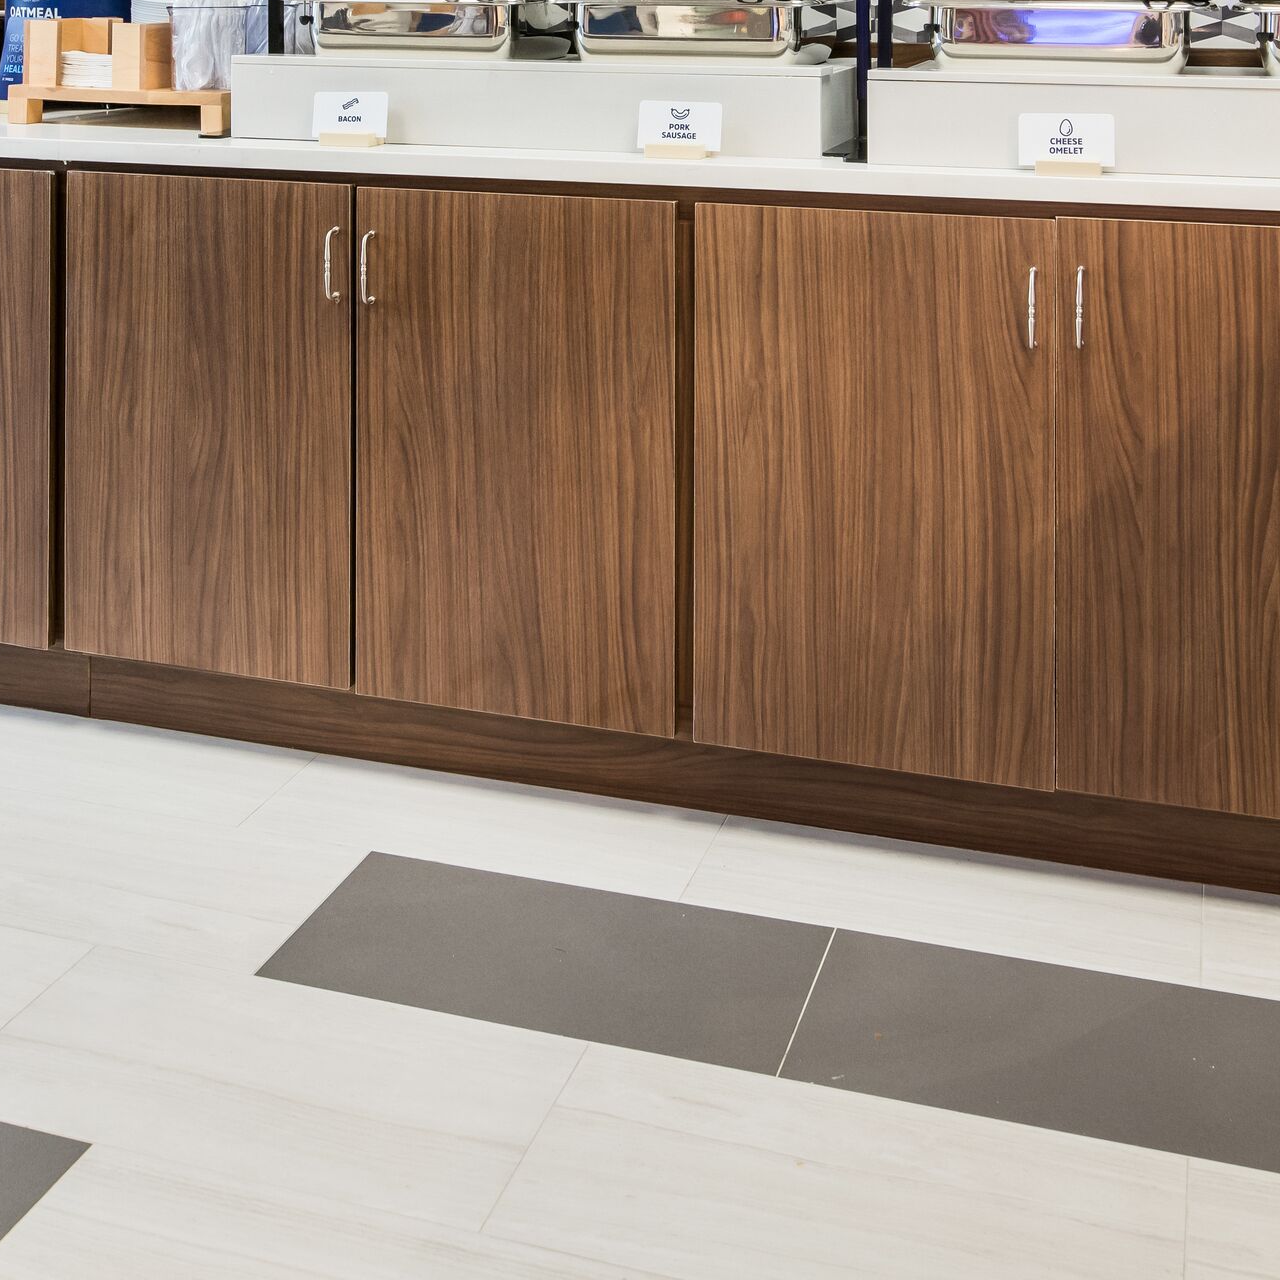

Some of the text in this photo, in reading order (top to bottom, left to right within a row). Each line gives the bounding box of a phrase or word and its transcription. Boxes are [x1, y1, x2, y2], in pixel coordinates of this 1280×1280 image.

[10, 6, 63, 19] OATMEAL
[9, 33, 19, 43] GO
[7, 44, 24, 53] TREA
